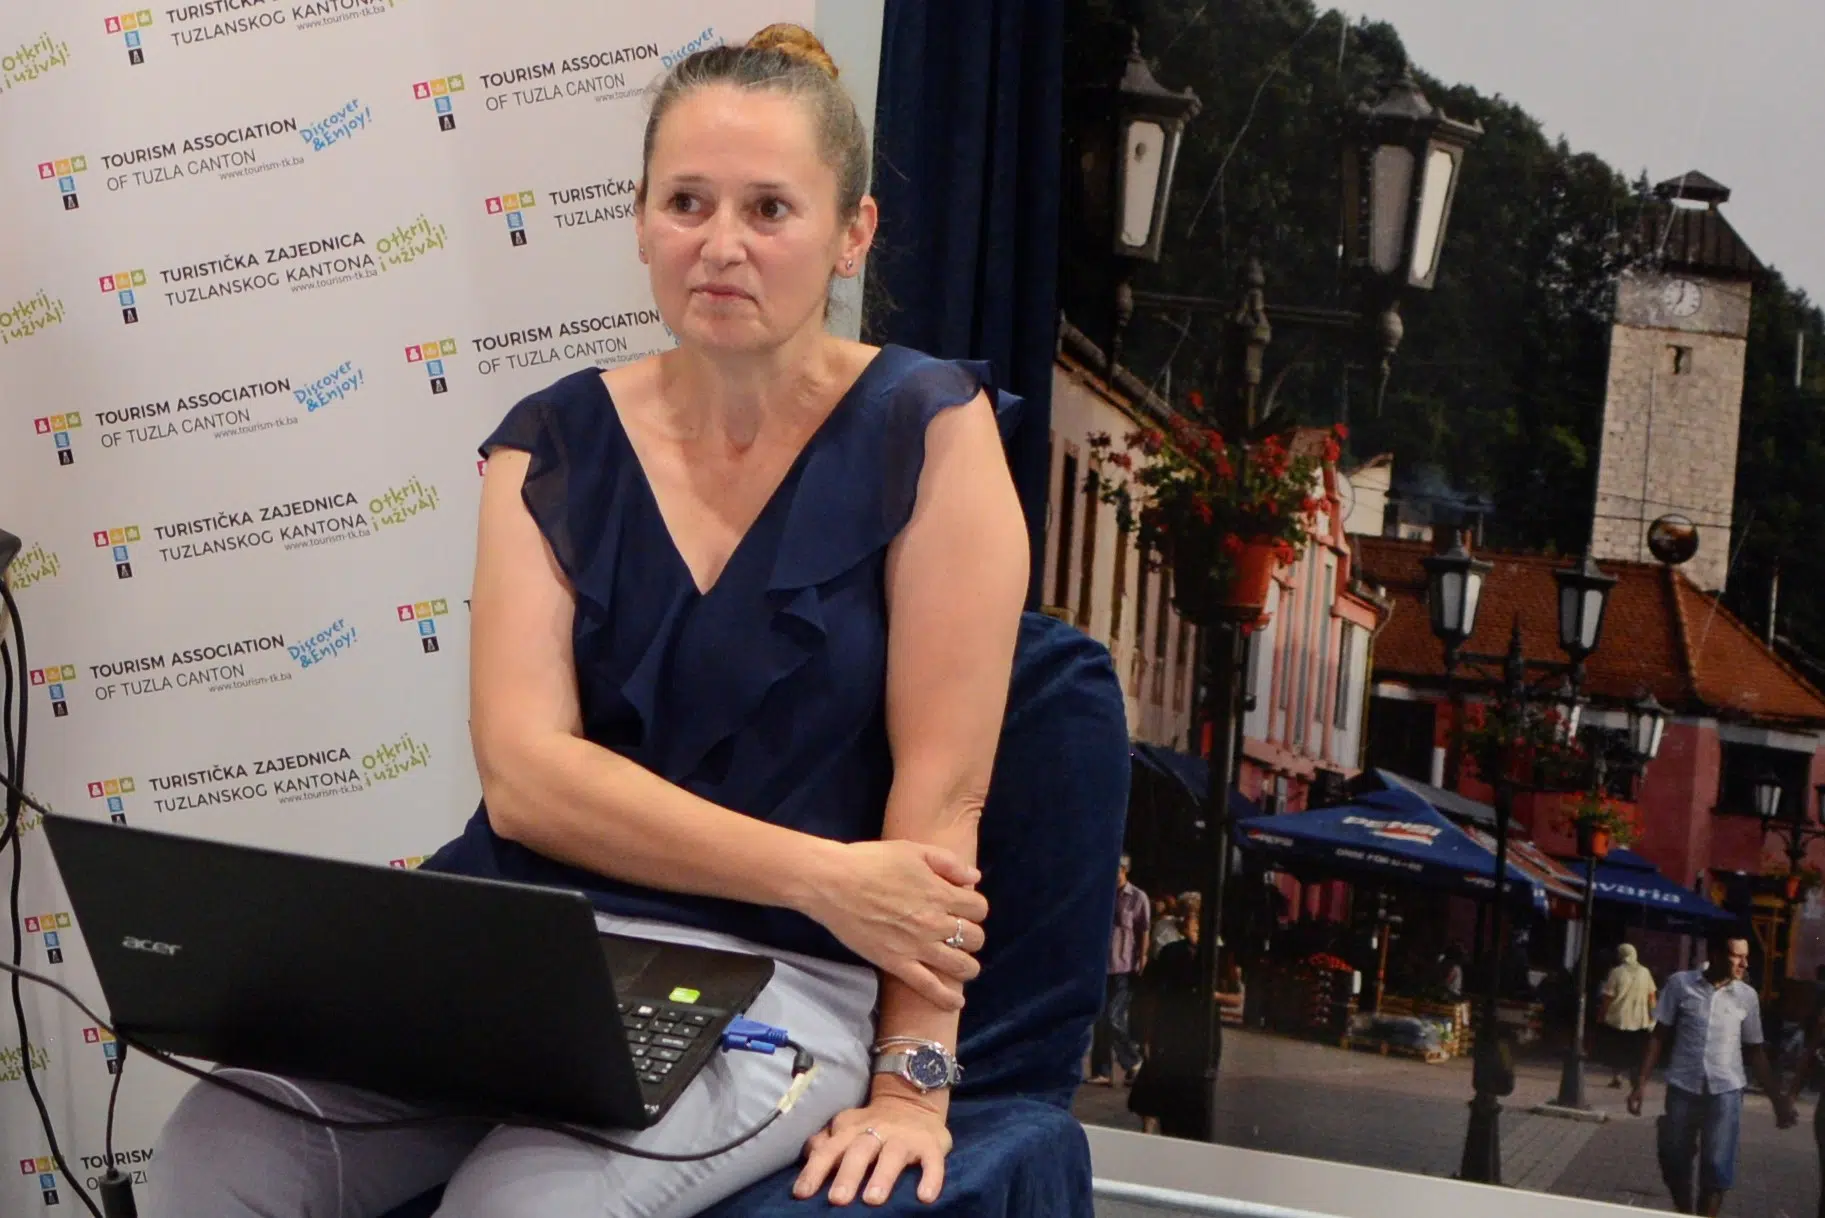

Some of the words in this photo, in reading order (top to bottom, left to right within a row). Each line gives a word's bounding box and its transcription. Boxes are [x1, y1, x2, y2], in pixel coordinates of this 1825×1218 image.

[171, 10, 286, 47] TUZLANSKOG
[292, 0, 383, 20] KANTO
[480, 62, 555, 89] TOURISM
[561, 43, 659, 75] ASSOCIATION
[661, 27, 714, 69] Discover
[486, 95, 508, 111] OF
[512, 85, 563, 107] TUZLA
[566, 73, 625, 97] CANTON
[300, 99, 360, 144] Discover
[101, 142, 176, 170] TOURISM
[183, 118, 297, 153] ASSOCIATION
[107, 176, 129, 192] OF
[133, 165, 184, 187] TUZLA
[187, 149, 256, 176] CANTON
[549, 178, 636, 205] TURISTIČKA
[376, 214, 430, 254] Otkrij
[554, 204, 635, 228] TUZLANSK
[160, 253, 259, 284] TURISTIČKA
[265, 232, 365, 264] ZAJEDNICA
[165, 272, 280, 306] TUZLANSKOG
[285, 254, 374, 283] KANTONA
[472, 325, 552, 352] TOURISM
[559, 309, 660, 338] ASSOCIATION
[478, 358, 501, 376] OF
[505, 347, 560, 370] TUZLA
[564, 336, 627, 359] CANTON
[96, 401, 170, 426] TOURISM
[176, 378, 291, 411] ASSOCIATION
[294, 361, 352, 405] Discover
[101, 433, 123, 448] OF
[127, 423, 178, 444] TUZLA
[182, 409, 250, 434] CANTON
[369, 475, 422, 514] Otkrij
[154, 511, 253, 541] TURISTIČKA
[259, 492, 358, 521] ZAJEDNICA
[159, 531, 273, 562] TUZLANSKOG
[279, 514, 367, 542] KANTONA
[11, 541, 46, 573] tkrij
[90, 655, 165, 679] TOURISM
[172, 634, 284, 666] ASSOCIATION
[287, 618, 346, 661] Discover
[95, 685, 116, 700] OF
[120, 675, 173, 696] TUZLA
[177, 664, 244, 688] CANTON
[149, 765, 248, 792] TURISTIČKA
[254, 748, 350, 774] ZAJEDNICA
[361, 733, 414, 770] Otkrij
[154, 784, 268, 814] TUZLANSKOG
[274, 769, 360, 796] KANTONA
[122, 936, 182, 956] acer
